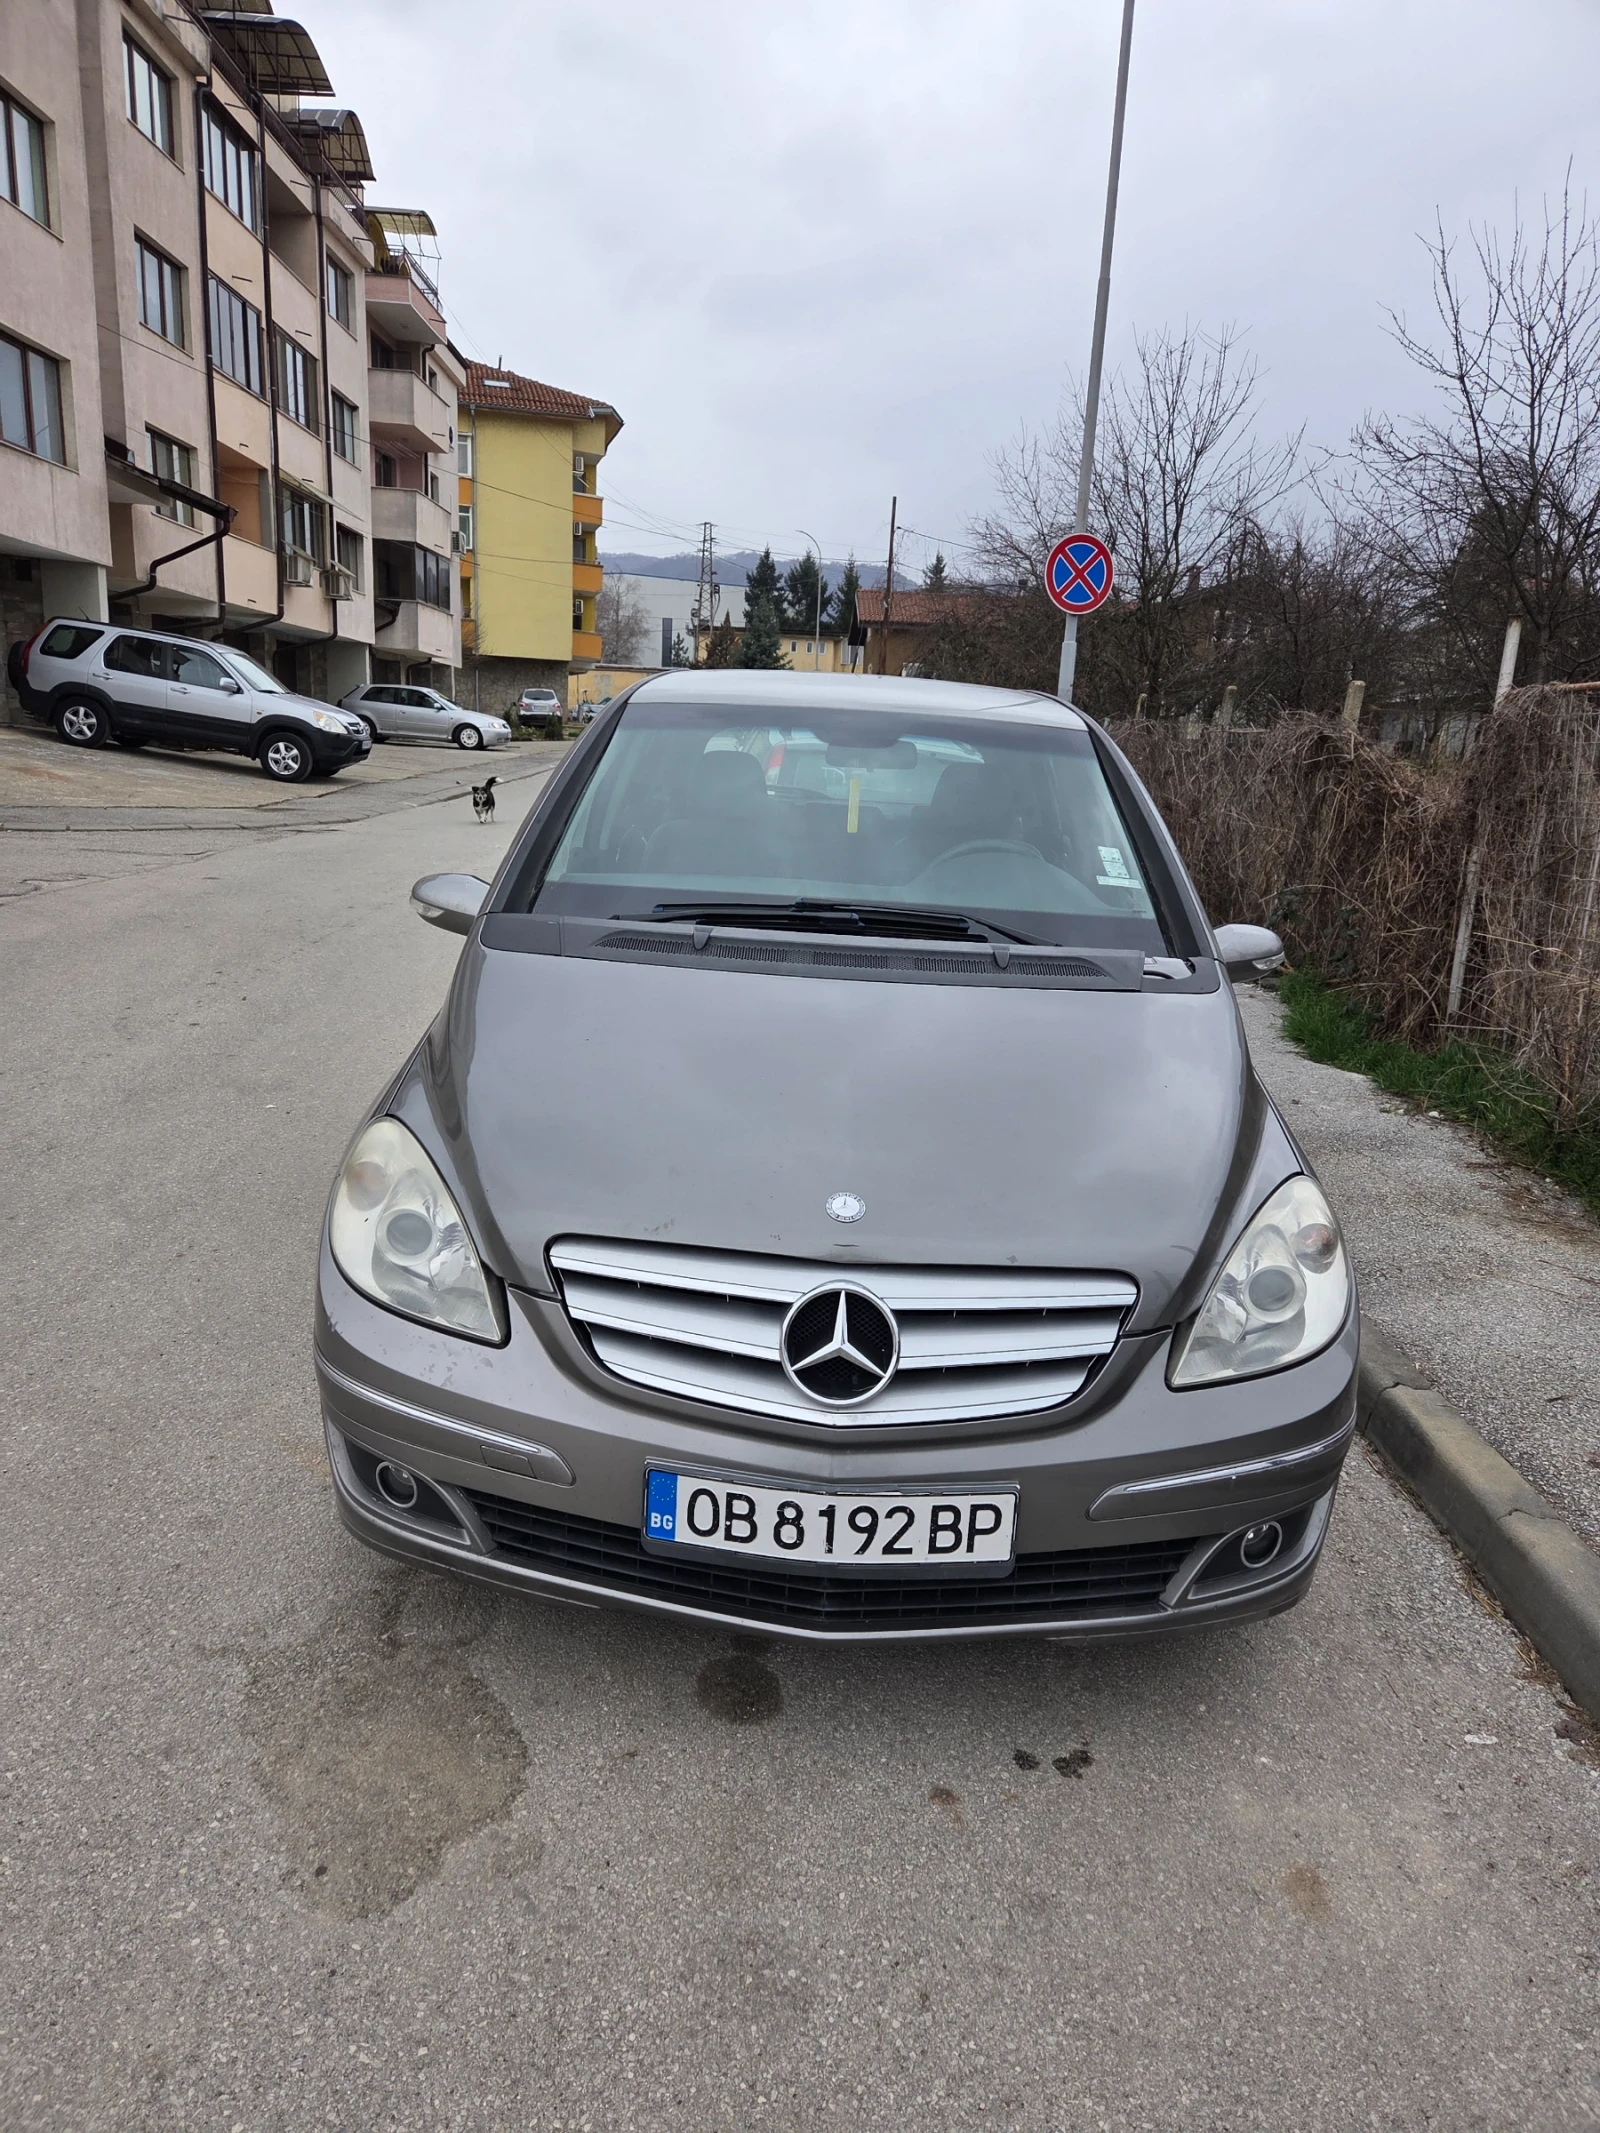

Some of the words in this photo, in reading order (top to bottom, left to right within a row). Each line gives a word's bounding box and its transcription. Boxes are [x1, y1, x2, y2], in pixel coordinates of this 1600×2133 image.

[650, 1512, 674, 1531] BG
[686, 1487, 758, 1544] OB
[773, 1500, 915, 1555] 8192
[928, 1504, 1003, 1555] BP
